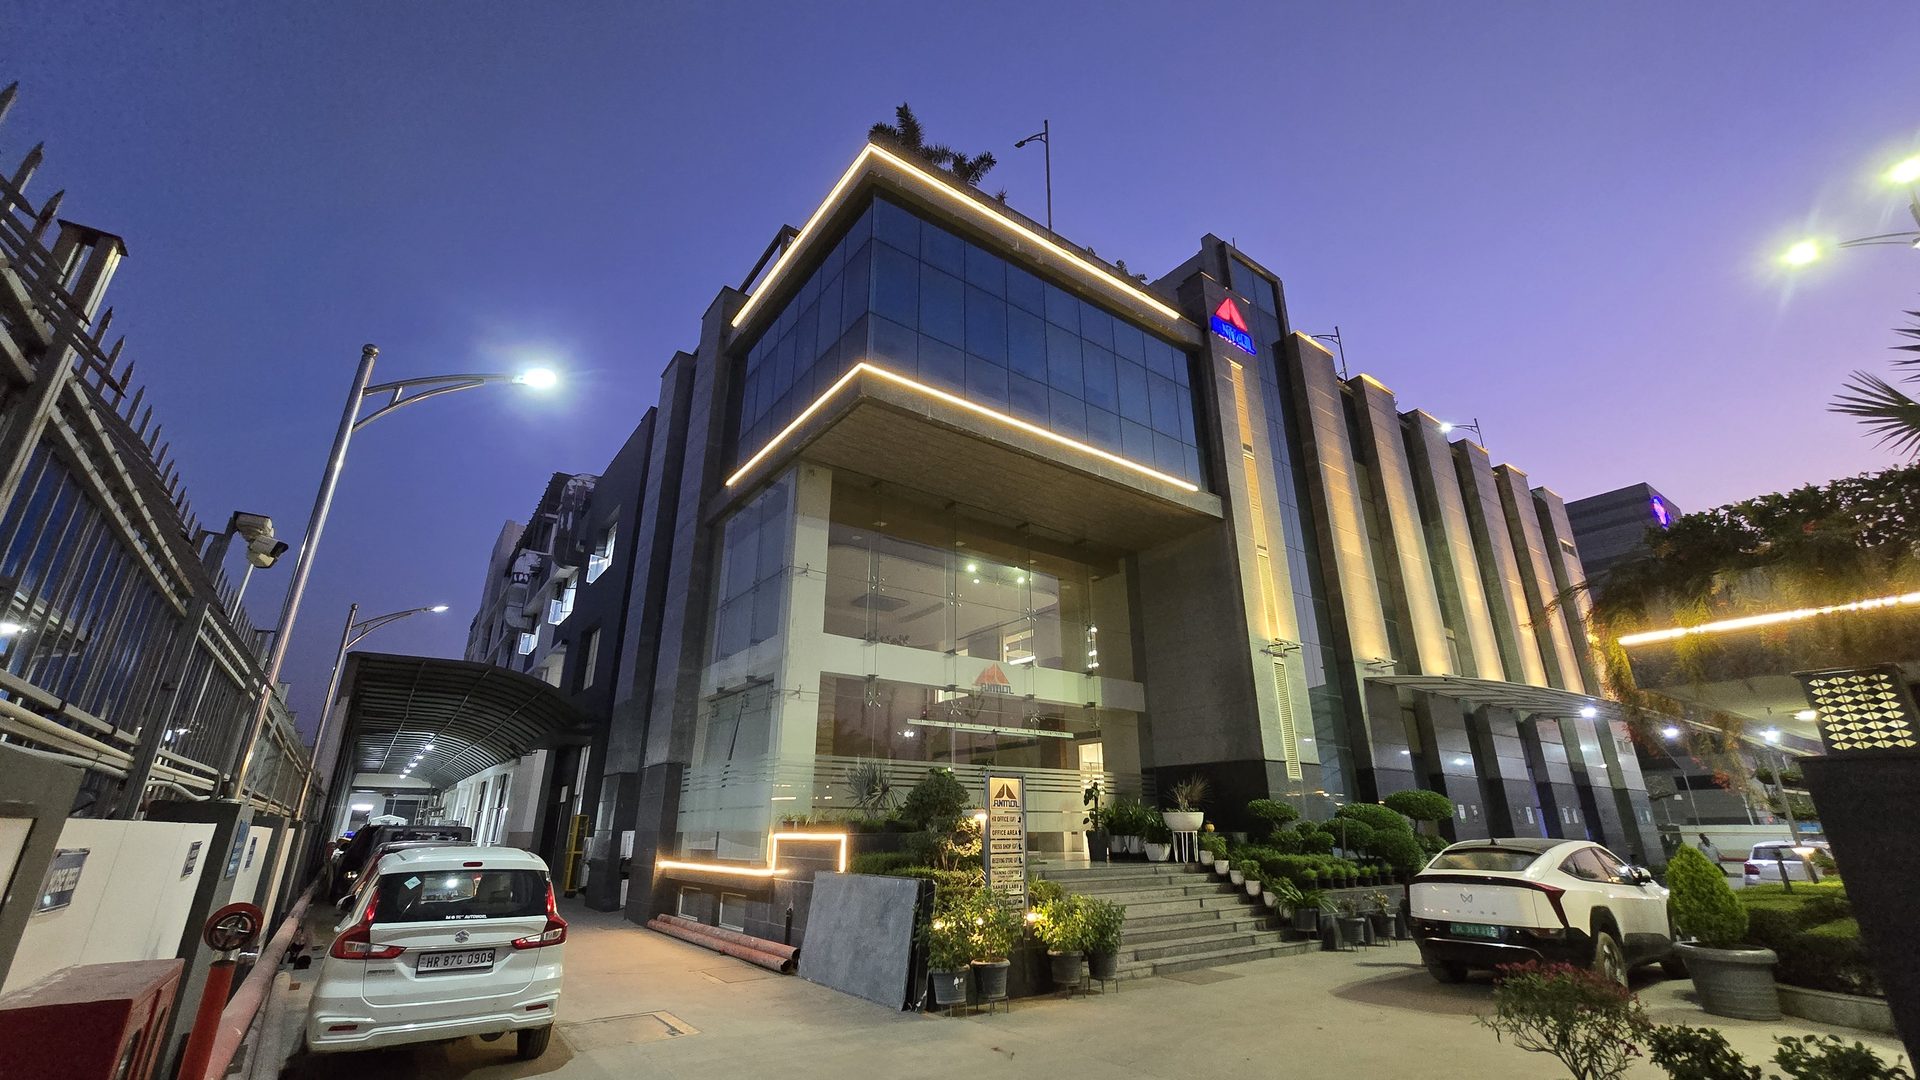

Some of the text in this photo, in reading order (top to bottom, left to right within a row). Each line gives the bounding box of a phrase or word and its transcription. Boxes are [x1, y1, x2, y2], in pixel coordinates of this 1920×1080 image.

[425, 952, 494, 968] HR 87G 0909
